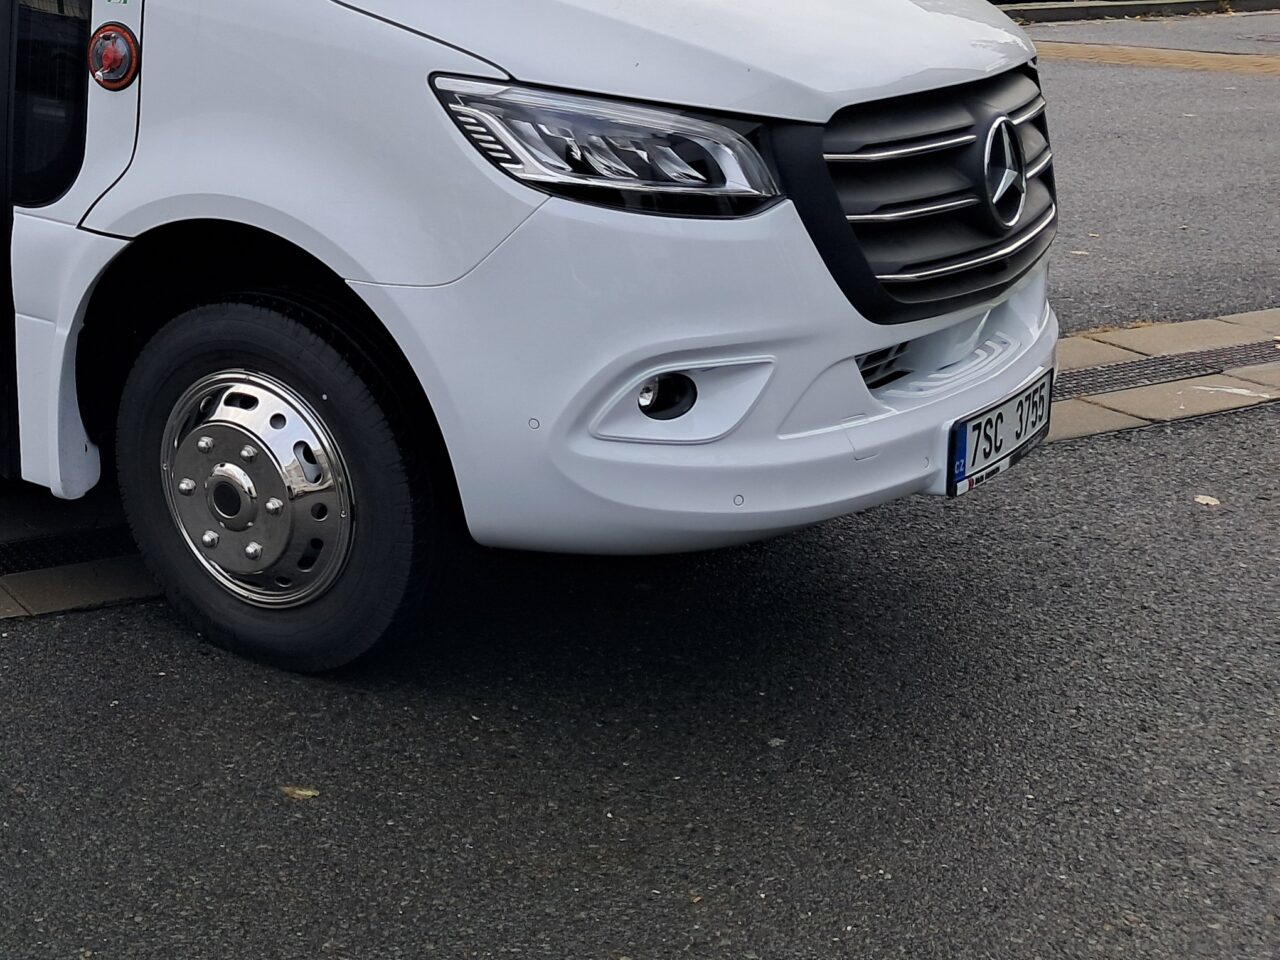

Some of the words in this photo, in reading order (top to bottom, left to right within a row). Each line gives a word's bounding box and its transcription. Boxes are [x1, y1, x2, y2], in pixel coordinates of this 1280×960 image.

[971, 411, 1004, 468] 7SC
[1015, 381, 1047, 440] 3755
[954, 458, 965, 474] CZ
